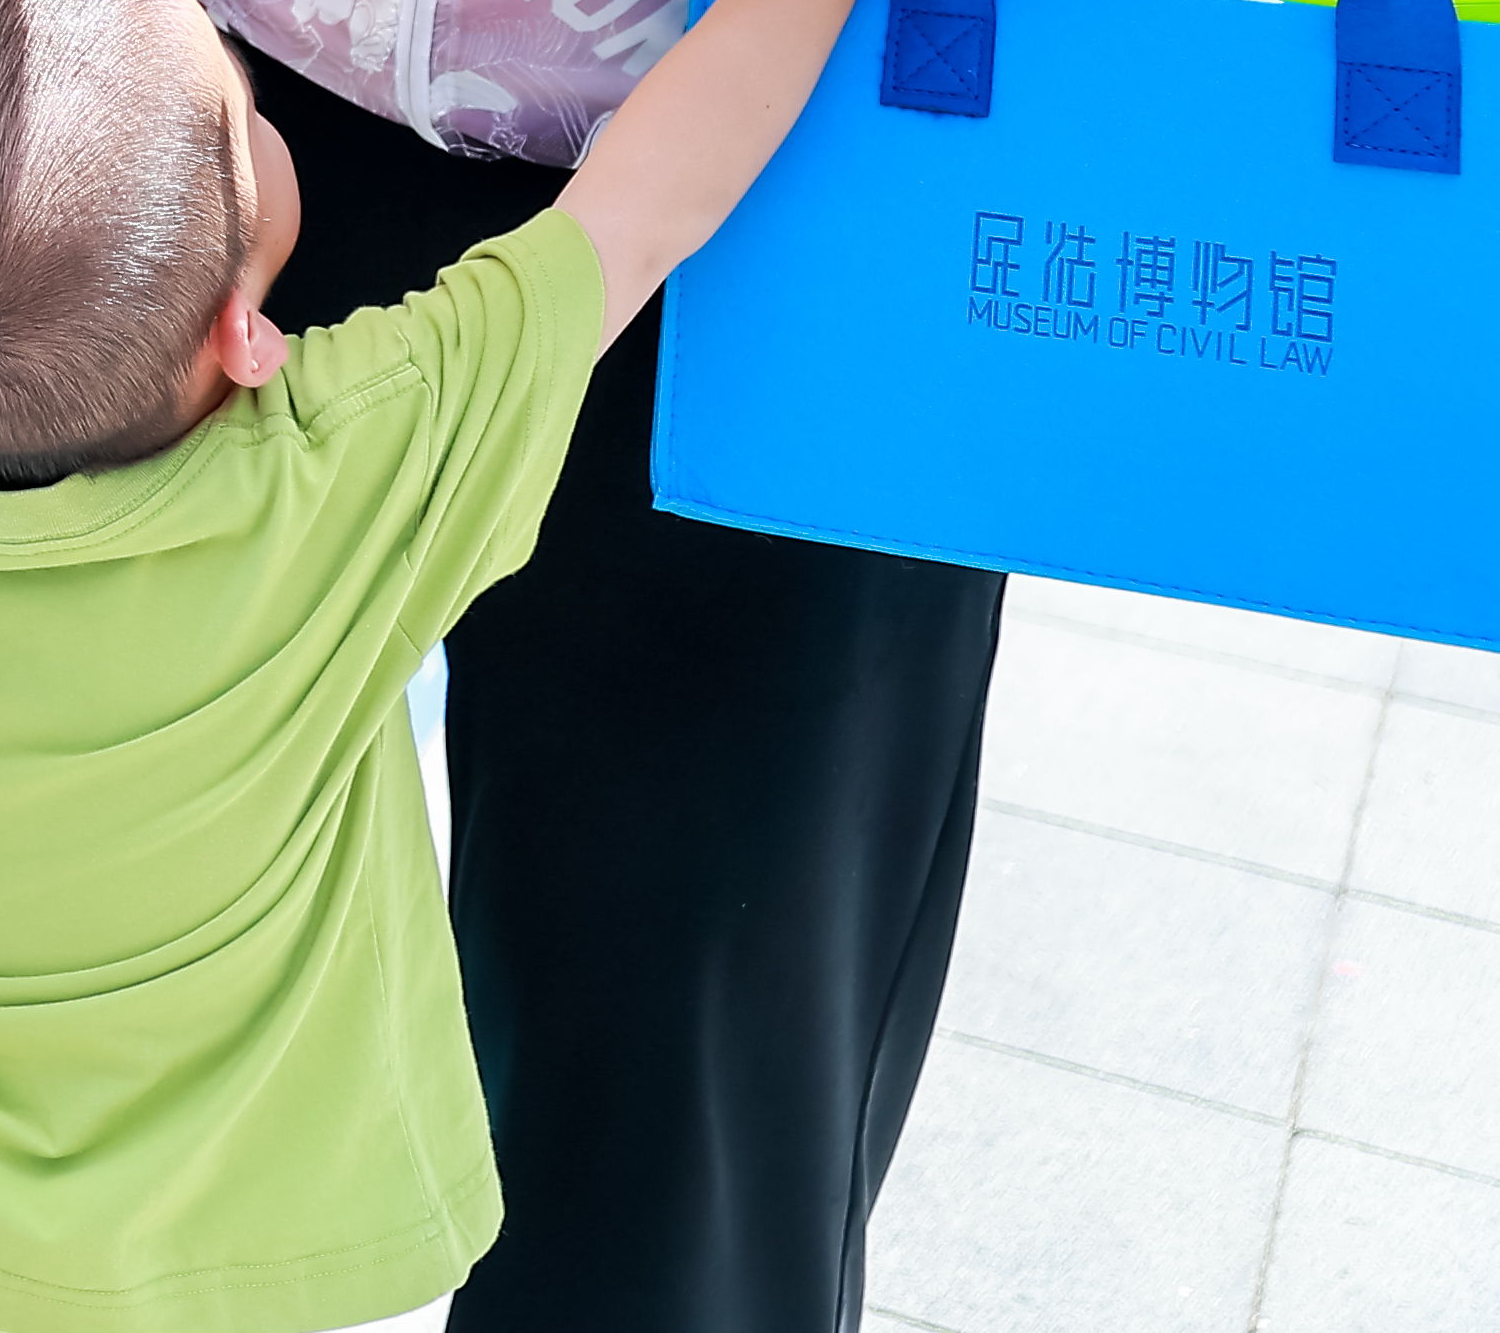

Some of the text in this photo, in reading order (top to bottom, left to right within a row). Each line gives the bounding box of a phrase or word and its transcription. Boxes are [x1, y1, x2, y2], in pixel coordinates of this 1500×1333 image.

[966, 295, 1334, 377] MUSEUM OF CIVIL LAW
